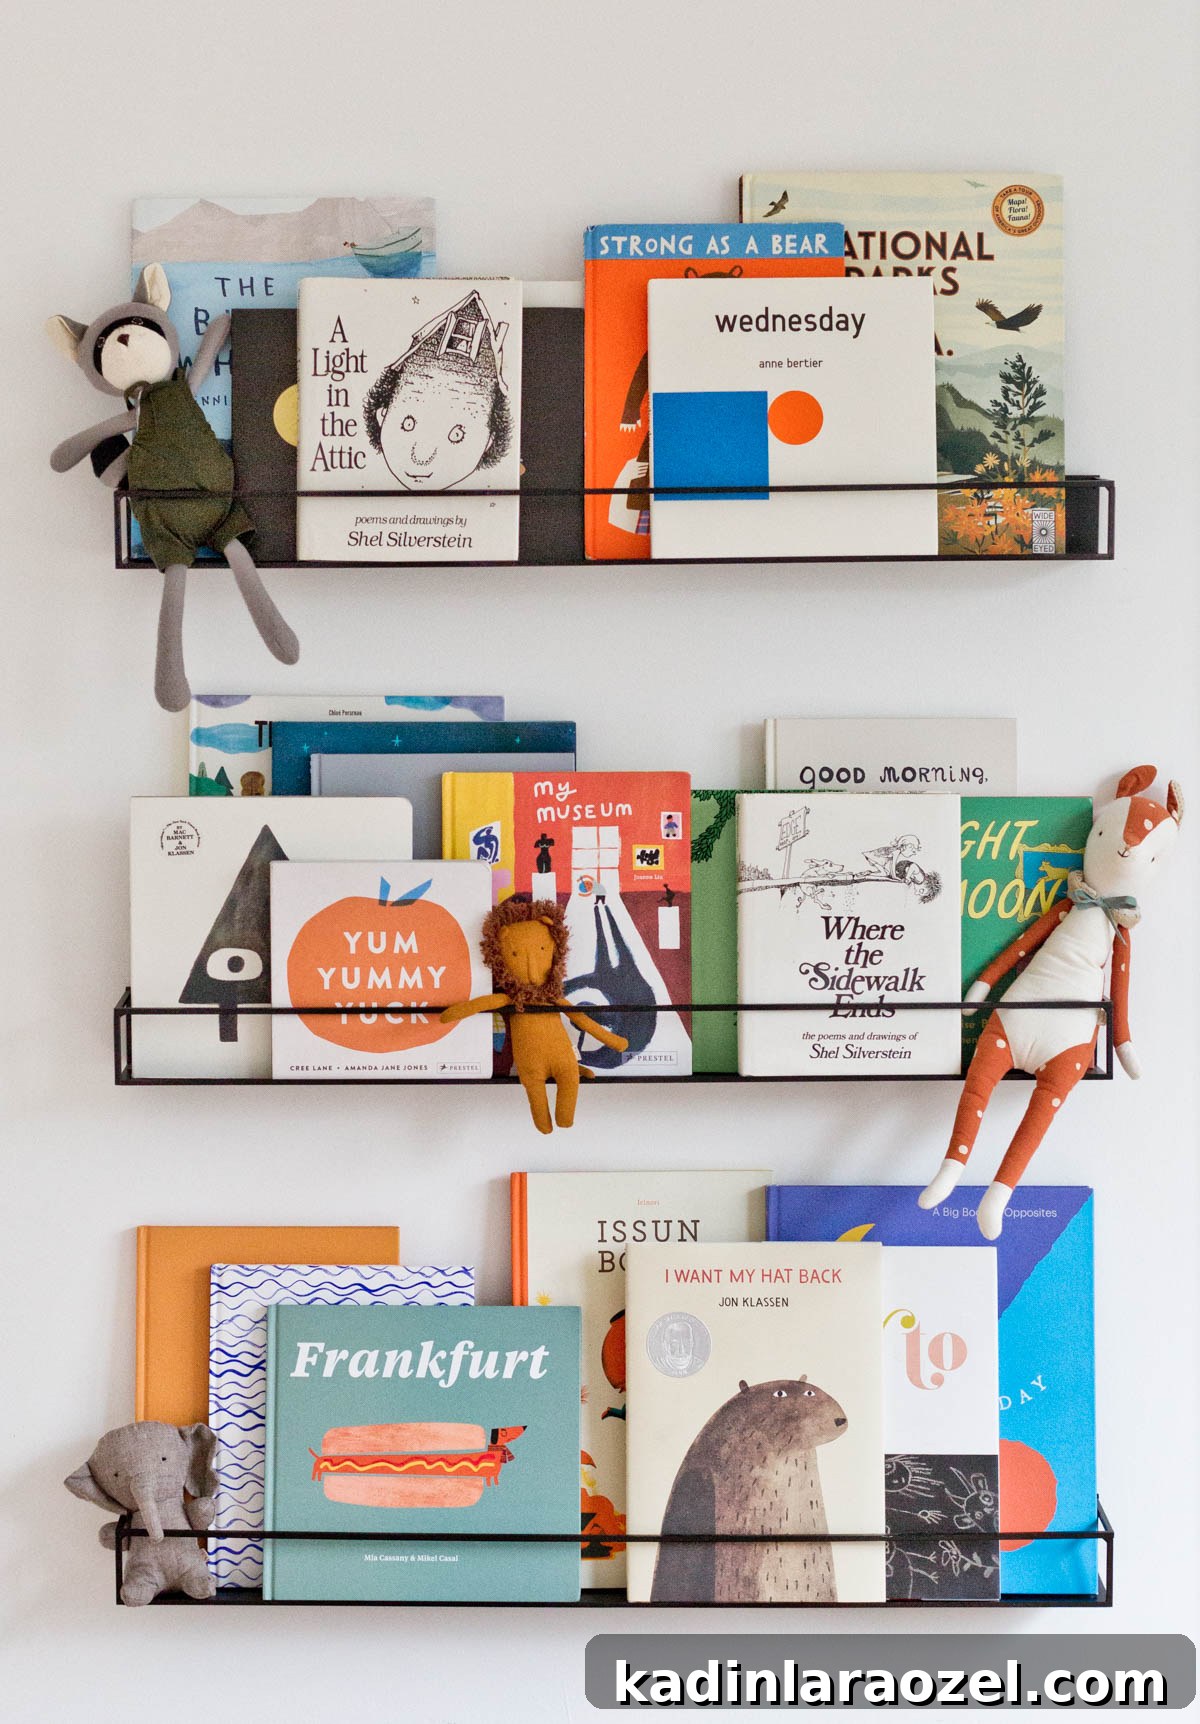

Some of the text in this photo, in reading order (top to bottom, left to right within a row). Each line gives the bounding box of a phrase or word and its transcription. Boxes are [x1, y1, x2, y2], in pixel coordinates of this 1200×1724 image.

[1008, 198, 1027, 206] Maps!
[1008, 214, 1030, 222] Fauna!
[600, 234, 829, 256] STRONG AS A BEAR
[214, 277, 274, 297] THE
[329, 315, 348, 343] A
[715, 306, 866, 339] wednesday
[312, 348, 368, 382] Light
[759, 358, 823, 368] anne bertier
[326, 384, 350, 408] in
[320, 411, 358, 437] the
[310, 441, 366, 472] Attic
[355, 515, 467, 527] poems and drawings by
[348, 531, 472, 548] Shel Silverstein
[821, 916, 905, 940] Where
[344, 931, 418, 954] YUM
[844, 942, 884, 968] the
[317, 966, 446, 990] YUMMY
[799, 962, 926, 995] Sidewalk
[334, 1002, 430, 1024] YUCK
[828, 994, 896, 1018] Ends
[802, 1032, 919, 1042] the poems and drawings of
[809, 1044, 912, 1059] Shel Silverstein
[932, 1208, 940, 1216] A
[943, 1208, 959, 1218] Big
[1004, 1208, 1058, 1218] Opposites
[598, 1220, 700, 1242] ISSUN
[665, 1268, 842, 1284] I WANT MY HAT BACK
[718, 1297, 789, 1308] JON KLASSEN
[290, 1340, 550, 1388] Frankfurt
[901, 1321, 968, 1390] to
[379, 1554, 408, 1563] Cassany
